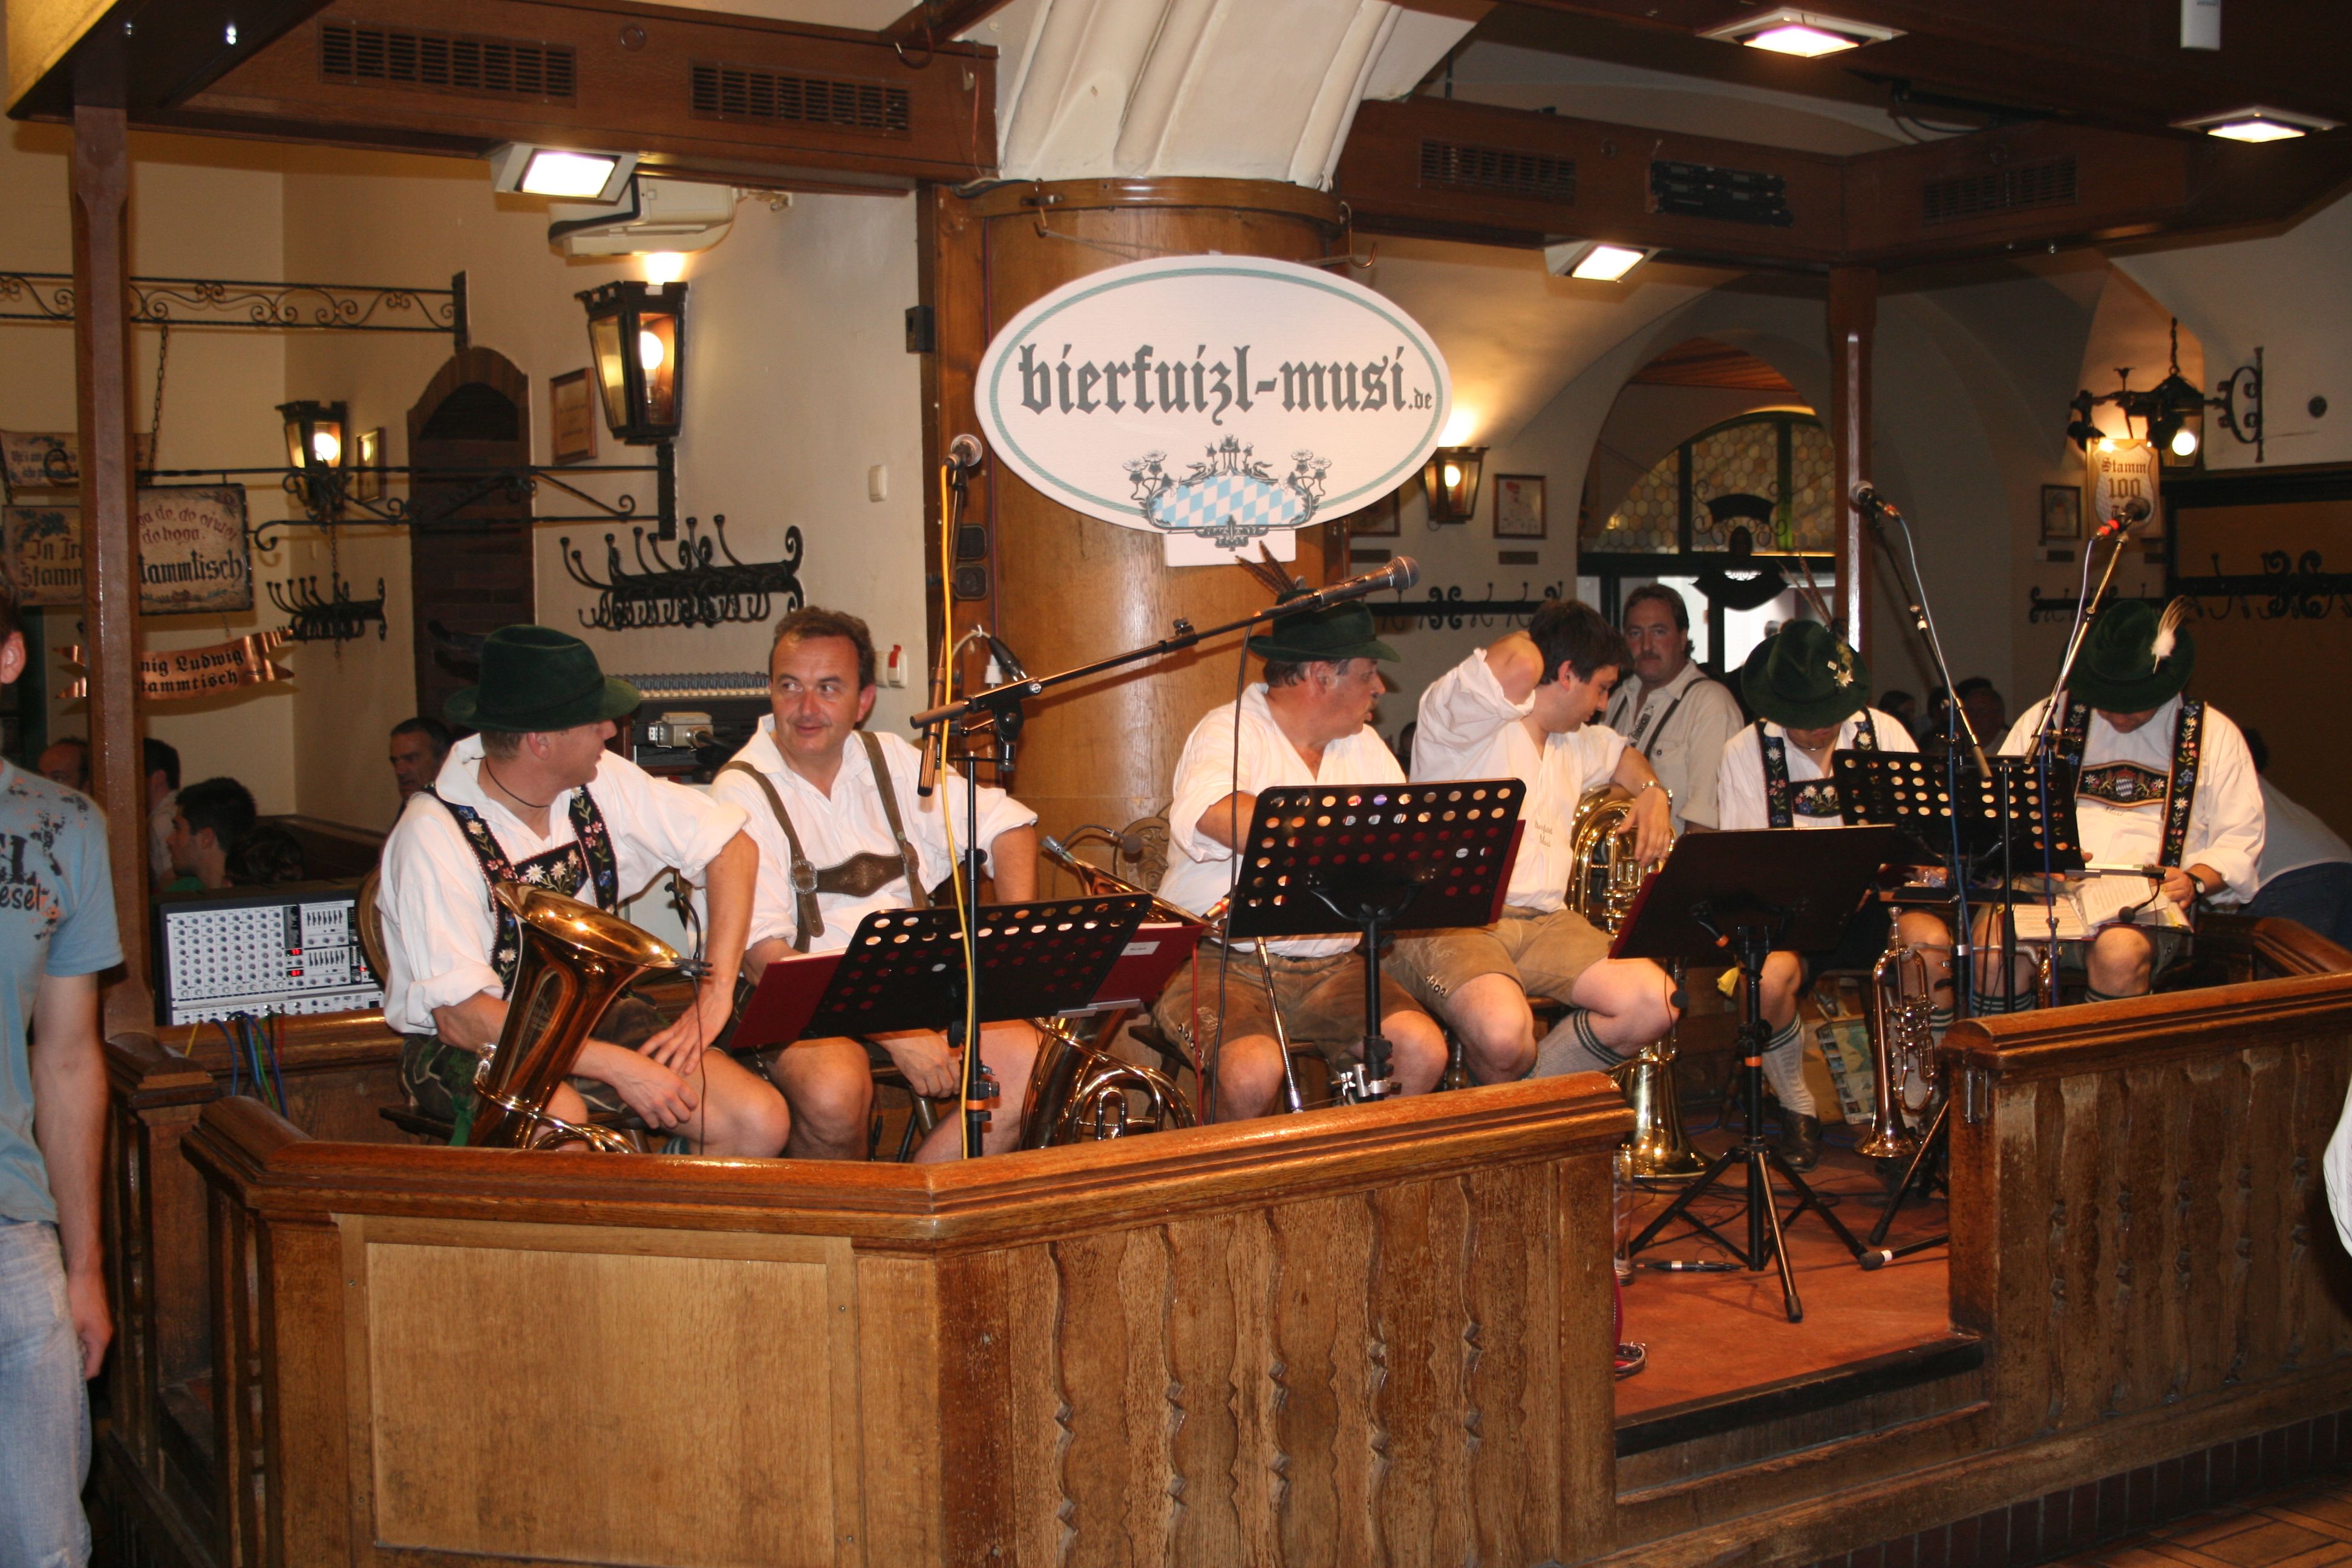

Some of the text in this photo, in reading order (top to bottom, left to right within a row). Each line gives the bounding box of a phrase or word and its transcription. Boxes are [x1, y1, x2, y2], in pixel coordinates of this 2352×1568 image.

[2101, 457, 2146, 474] Stamm
[2108, 477, 2141, 498] 100
[137, 549, 243, 585] tammtisch
[140, 648, 244, 677] nig Ludwig
[138, 669, 238, 693] tammtisch
[0, 883, 41, 912] esel
